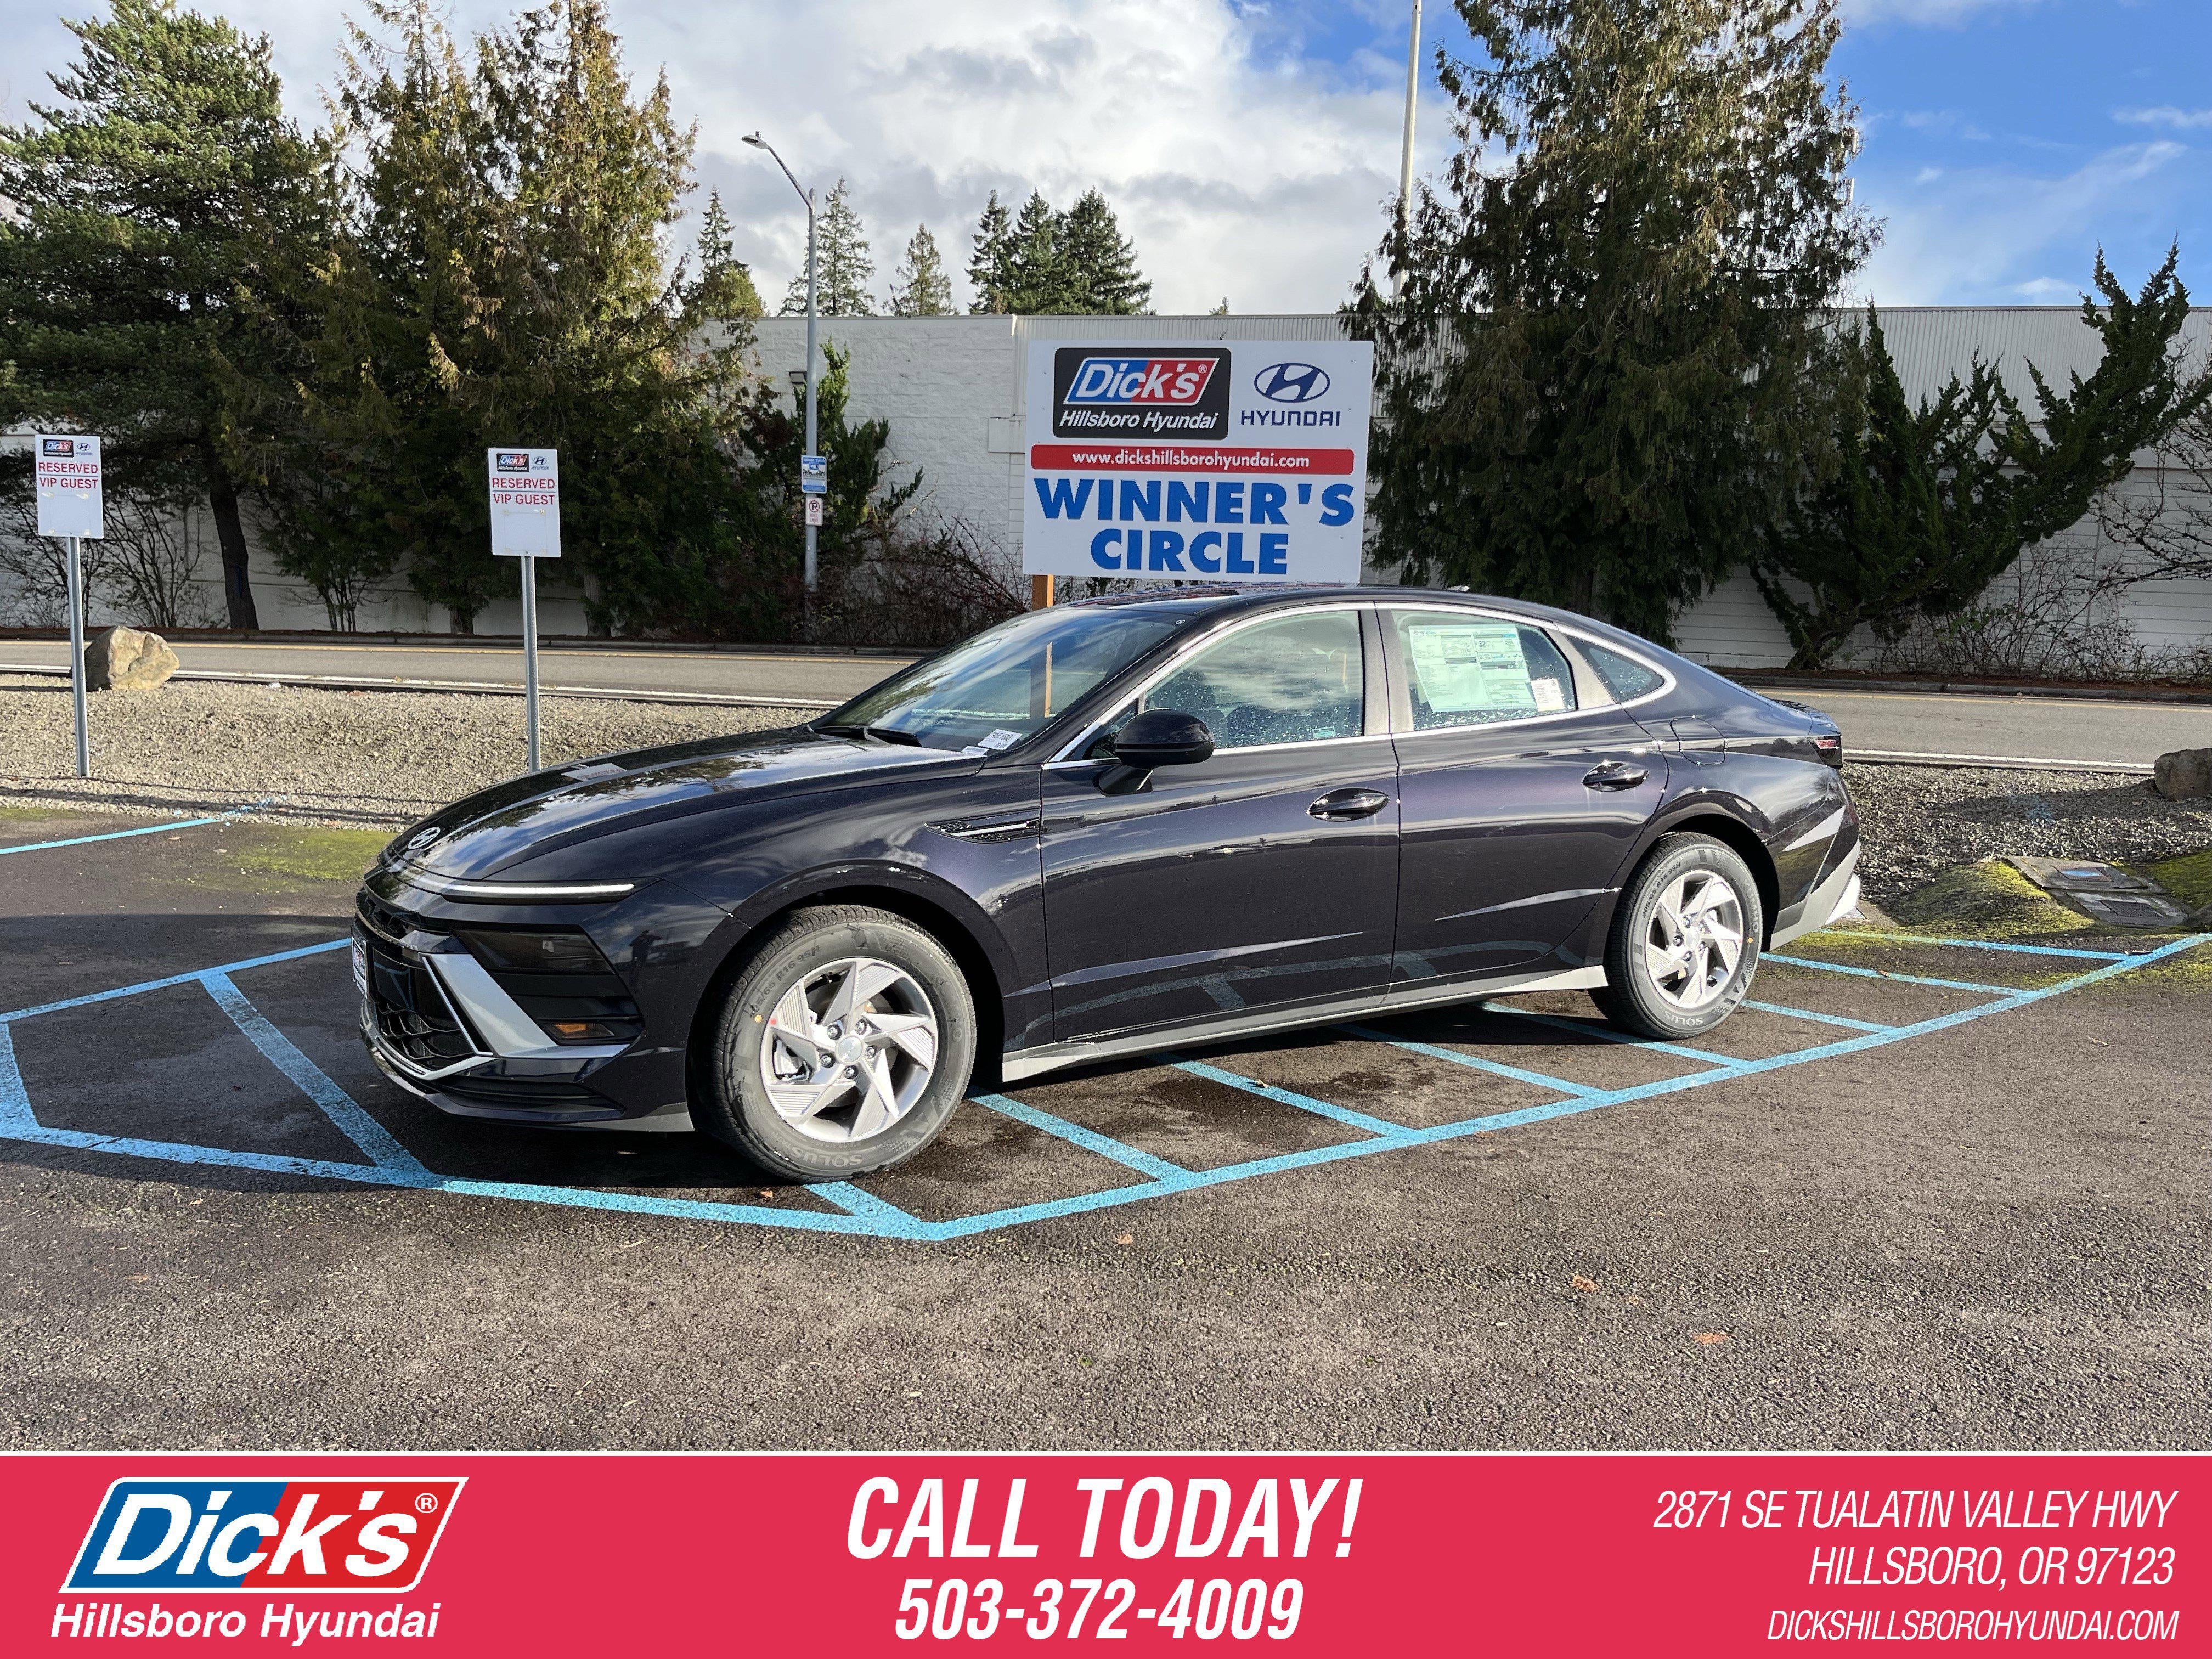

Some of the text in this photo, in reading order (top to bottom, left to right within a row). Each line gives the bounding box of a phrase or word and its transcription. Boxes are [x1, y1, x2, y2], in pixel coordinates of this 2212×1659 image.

[1059, 410, 1219, 432] Hillsboro Hyundai
[1240, 410, 1340, 427] HYUNDAI
[38, 462, 98, 473] RESERVED
[1072, 449, 1310, 471] www.dickshillsborohyundai.com
[40, 477, 99, 489] VIP GUEST
[492, 478, 555, 489] RESERVED
[493, 494, 556, 505] VIP GUEST
[1034, 478, 1355, 527] WINNER'S
[1090, 528, 1289, 575] CIRCLE
[775, 961, 795, 981] R16
[1663, 1010, 1704, 1026] SOLUS
[791, 1146, 864, 1167] SOLUS
